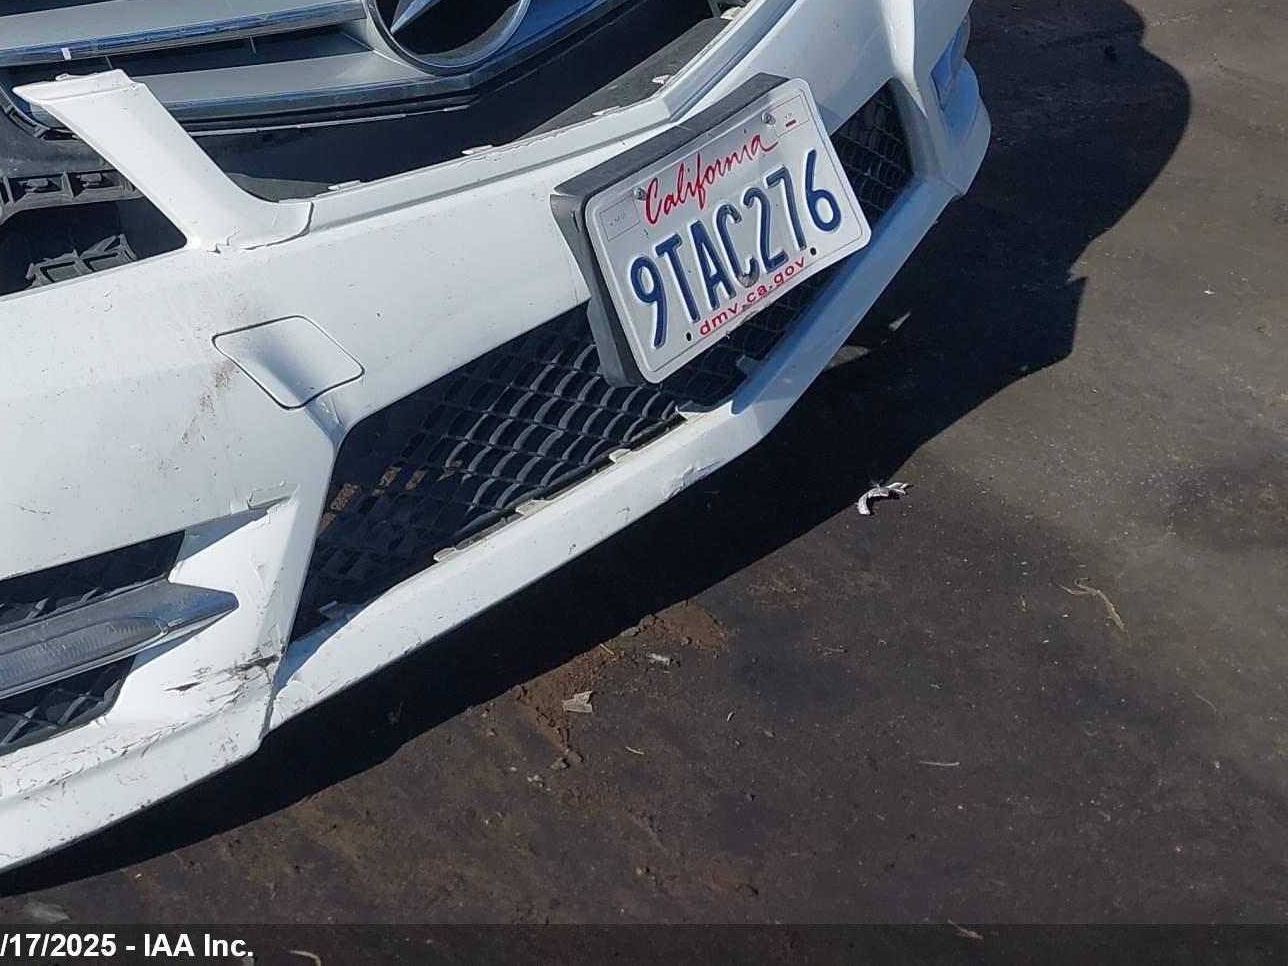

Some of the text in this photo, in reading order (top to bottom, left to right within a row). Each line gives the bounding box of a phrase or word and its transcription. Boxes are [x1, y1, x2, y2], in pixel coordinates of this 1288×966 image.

[644, 130, 779, 224] California
[629, 149, 842, 348] 9TAC276
[699, 257, 806, 336] dmv.ca.gov
